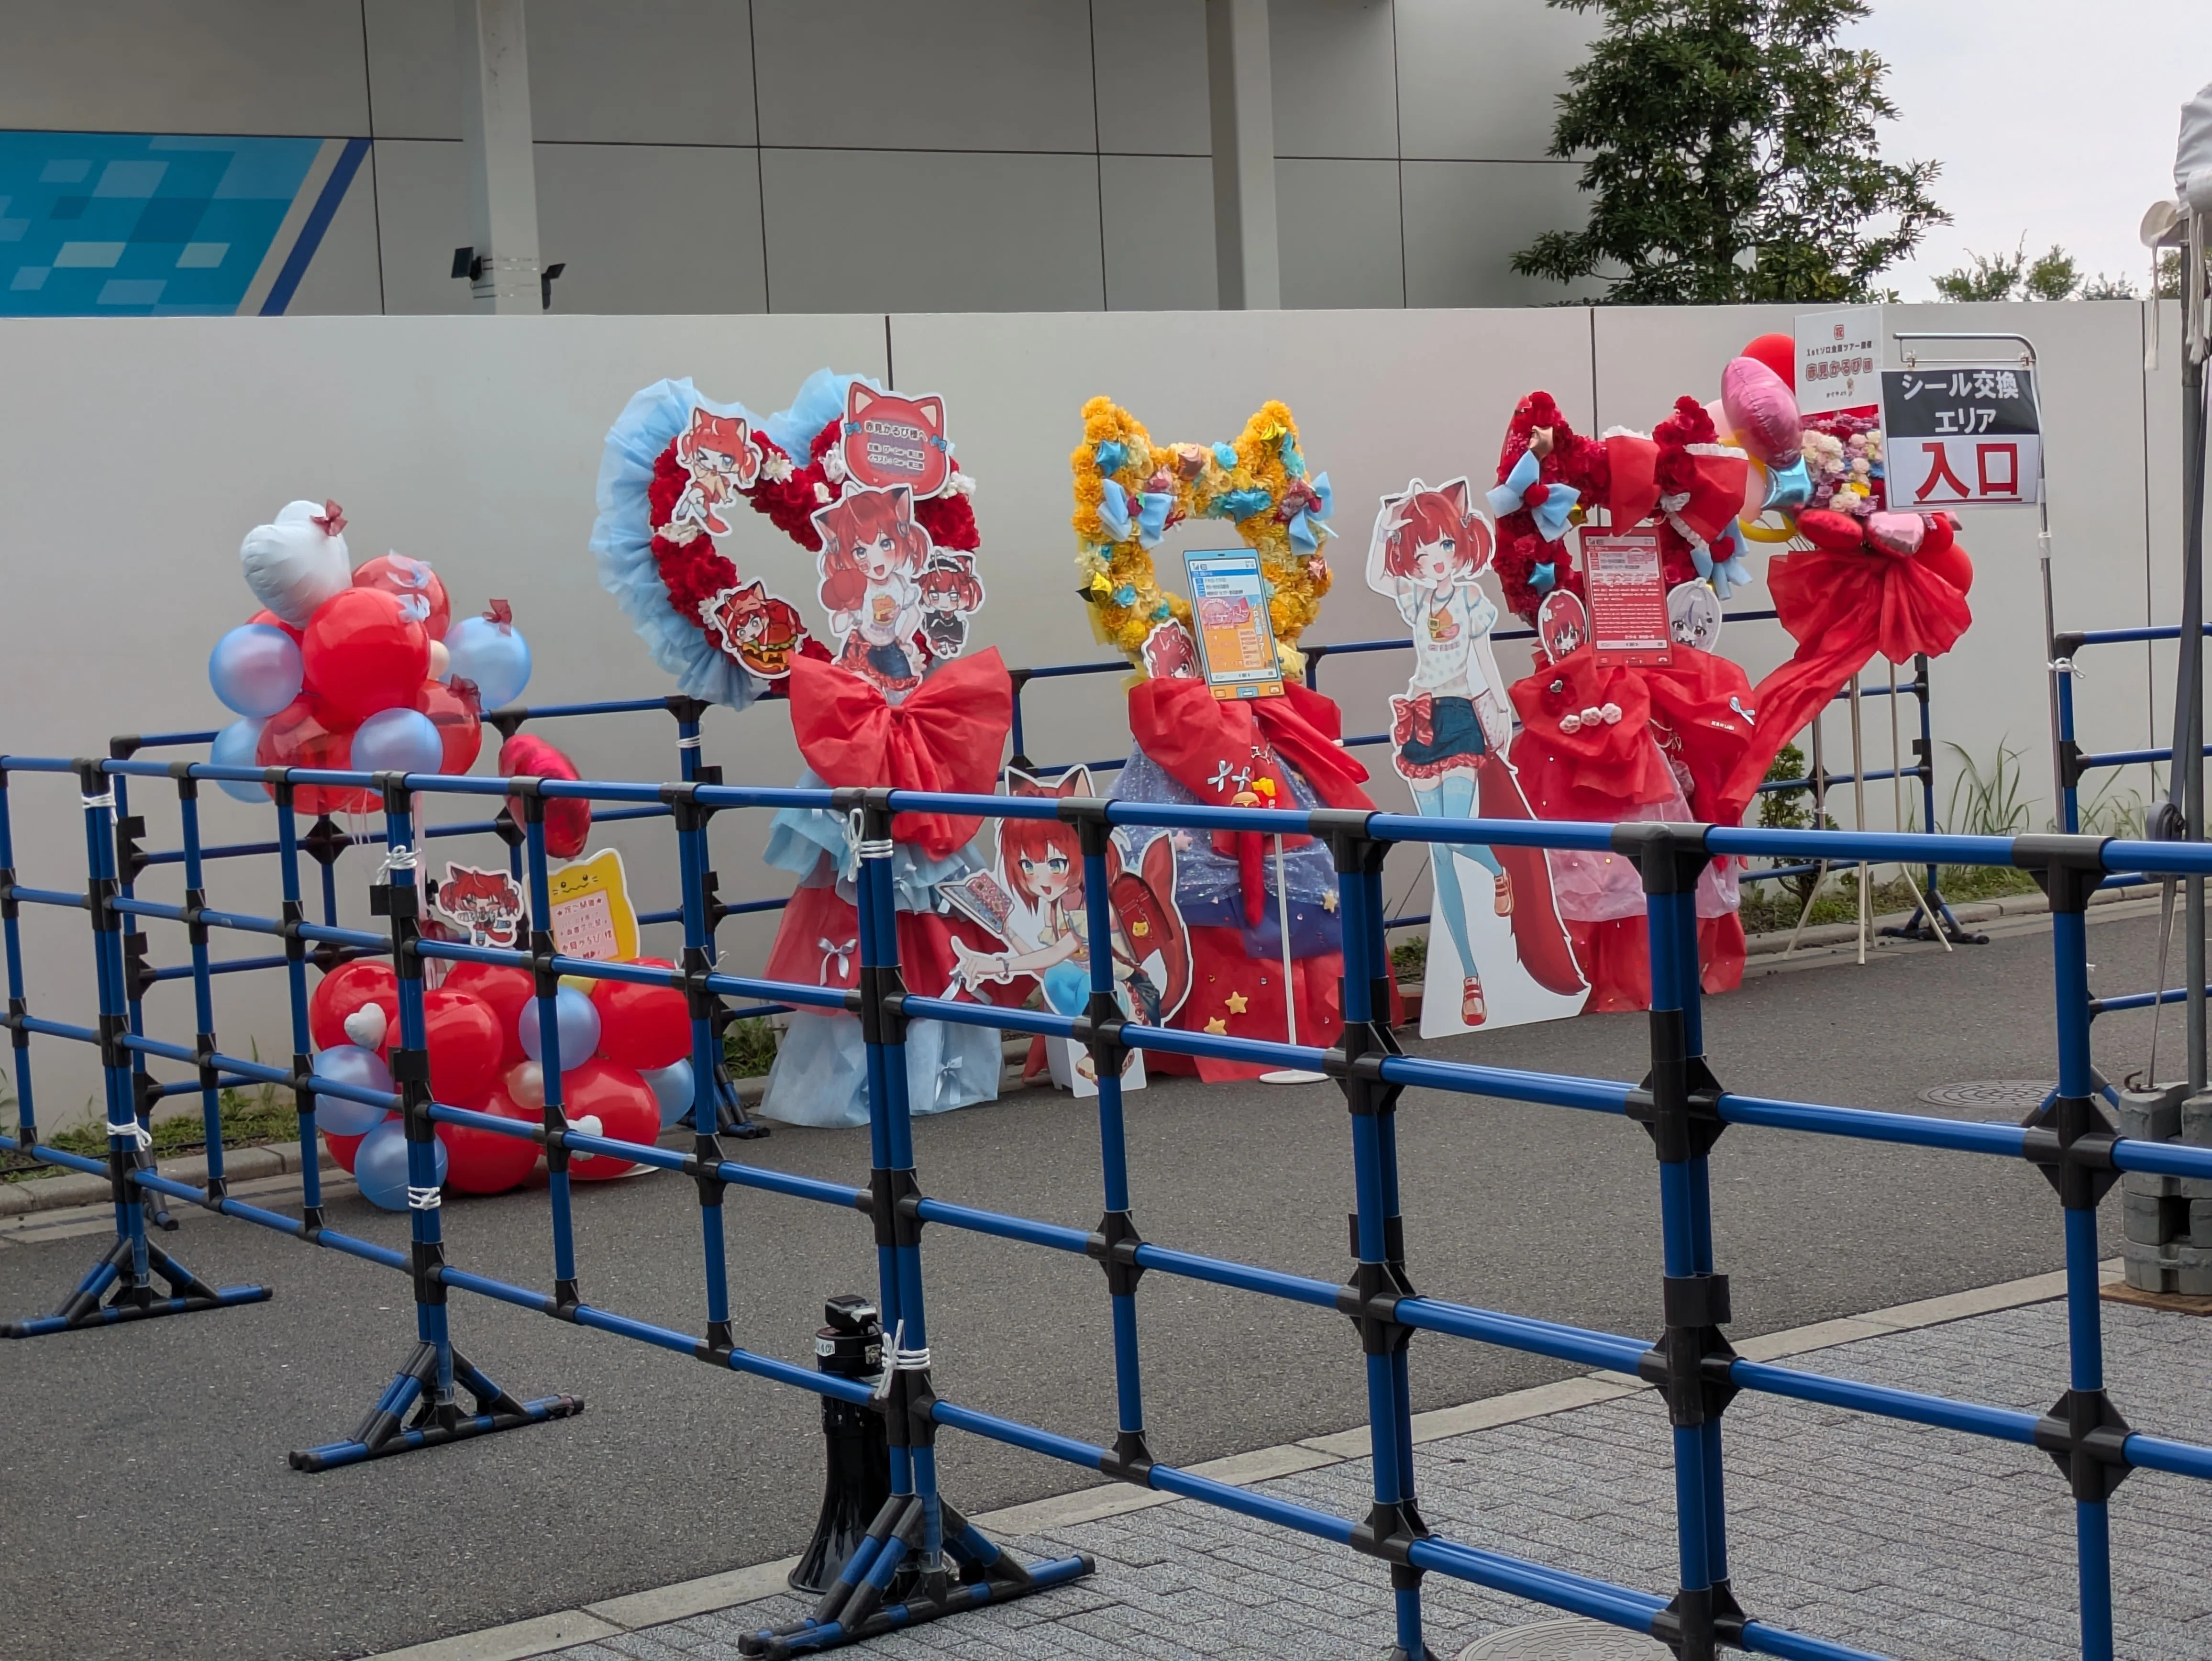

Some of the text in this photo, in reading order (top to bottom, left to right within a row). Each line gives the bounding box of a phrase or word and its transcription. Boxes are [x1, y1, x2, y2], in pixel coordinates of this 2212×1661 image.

[1902, 371, 2018, 400] シール交換
[1935, 408, 1996, 433] エリア
[1915, 442, 2018, 500] 入口
